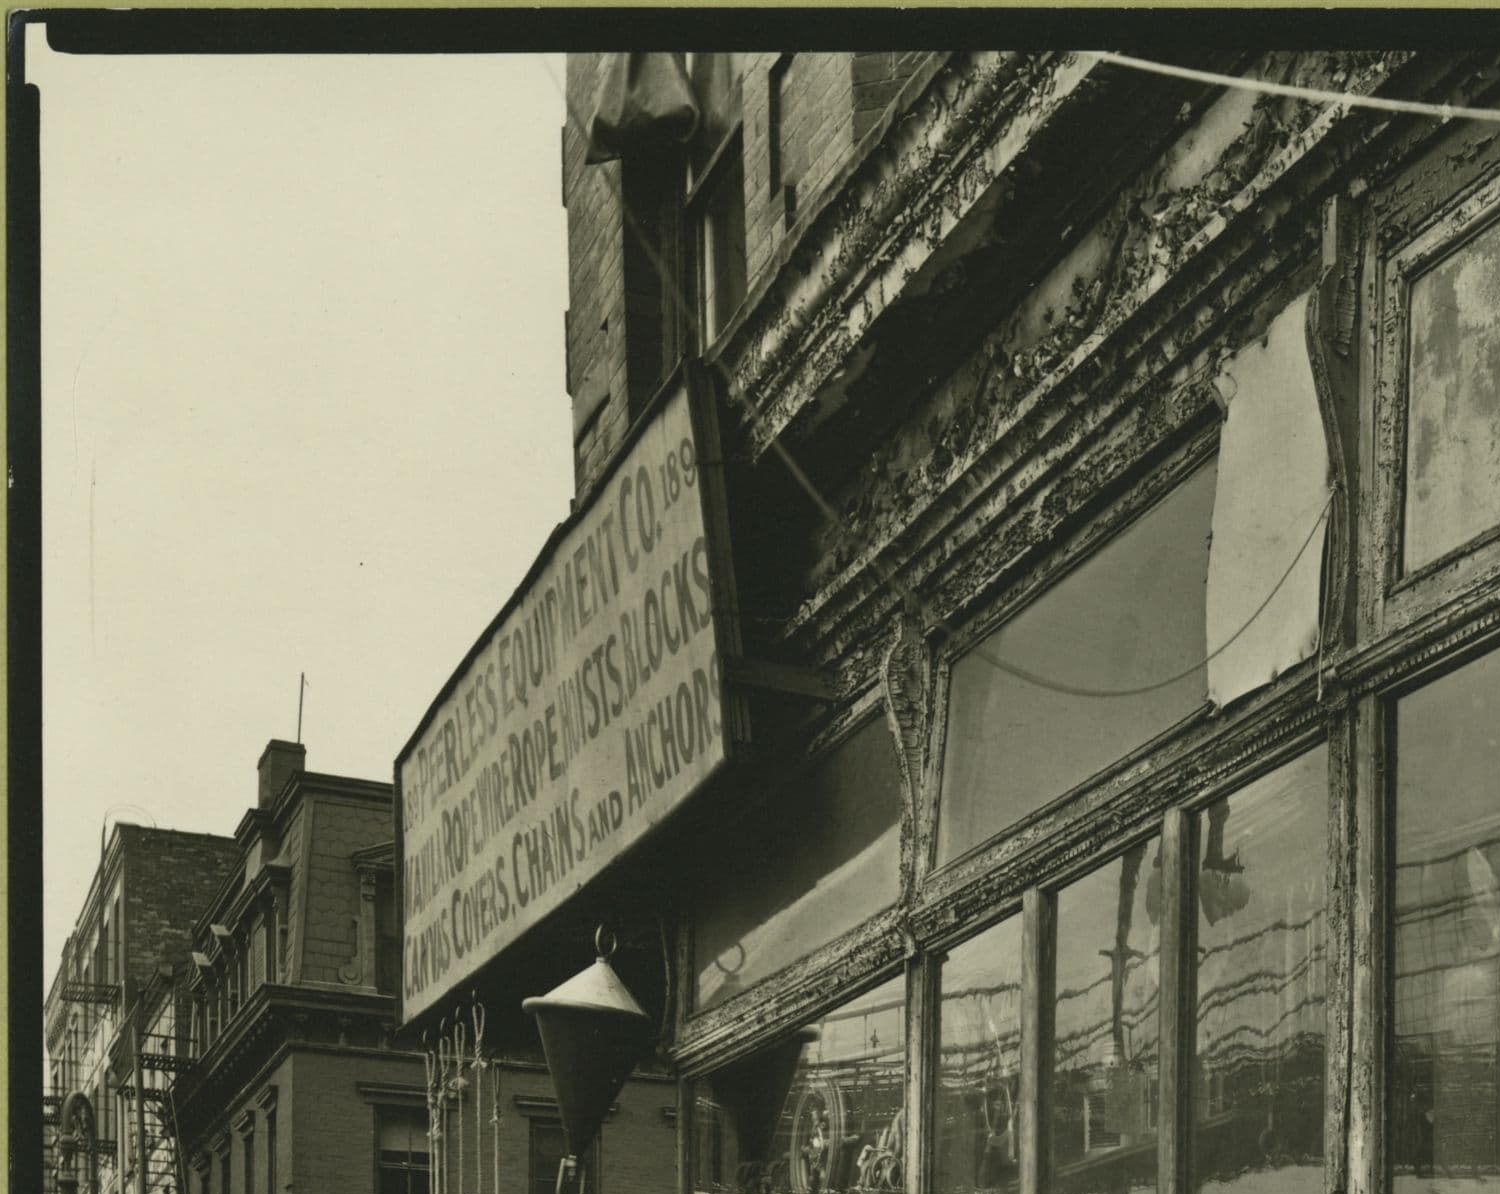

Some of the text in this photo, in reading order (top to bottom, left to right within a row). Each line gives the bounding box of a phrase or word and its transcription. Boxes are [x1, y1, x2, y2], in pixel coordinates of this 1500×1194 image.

[418, 662, 498, 806] PEERLESS
[498, 513, 621, 719] EQUIPMENT
[619, 465, 662, 574] CO.
[659, 437, 697, 512] 189
[476, 751, 515, 846] WIRE
[620, 536, 711, 700] BLOCKS
[404, 908, 450, 1001] CANVAS
[512, 787, 587, 908] CHAINS
[588, 790, 623, 848] AND
[624, 648, 722, 818] ANCHORS
